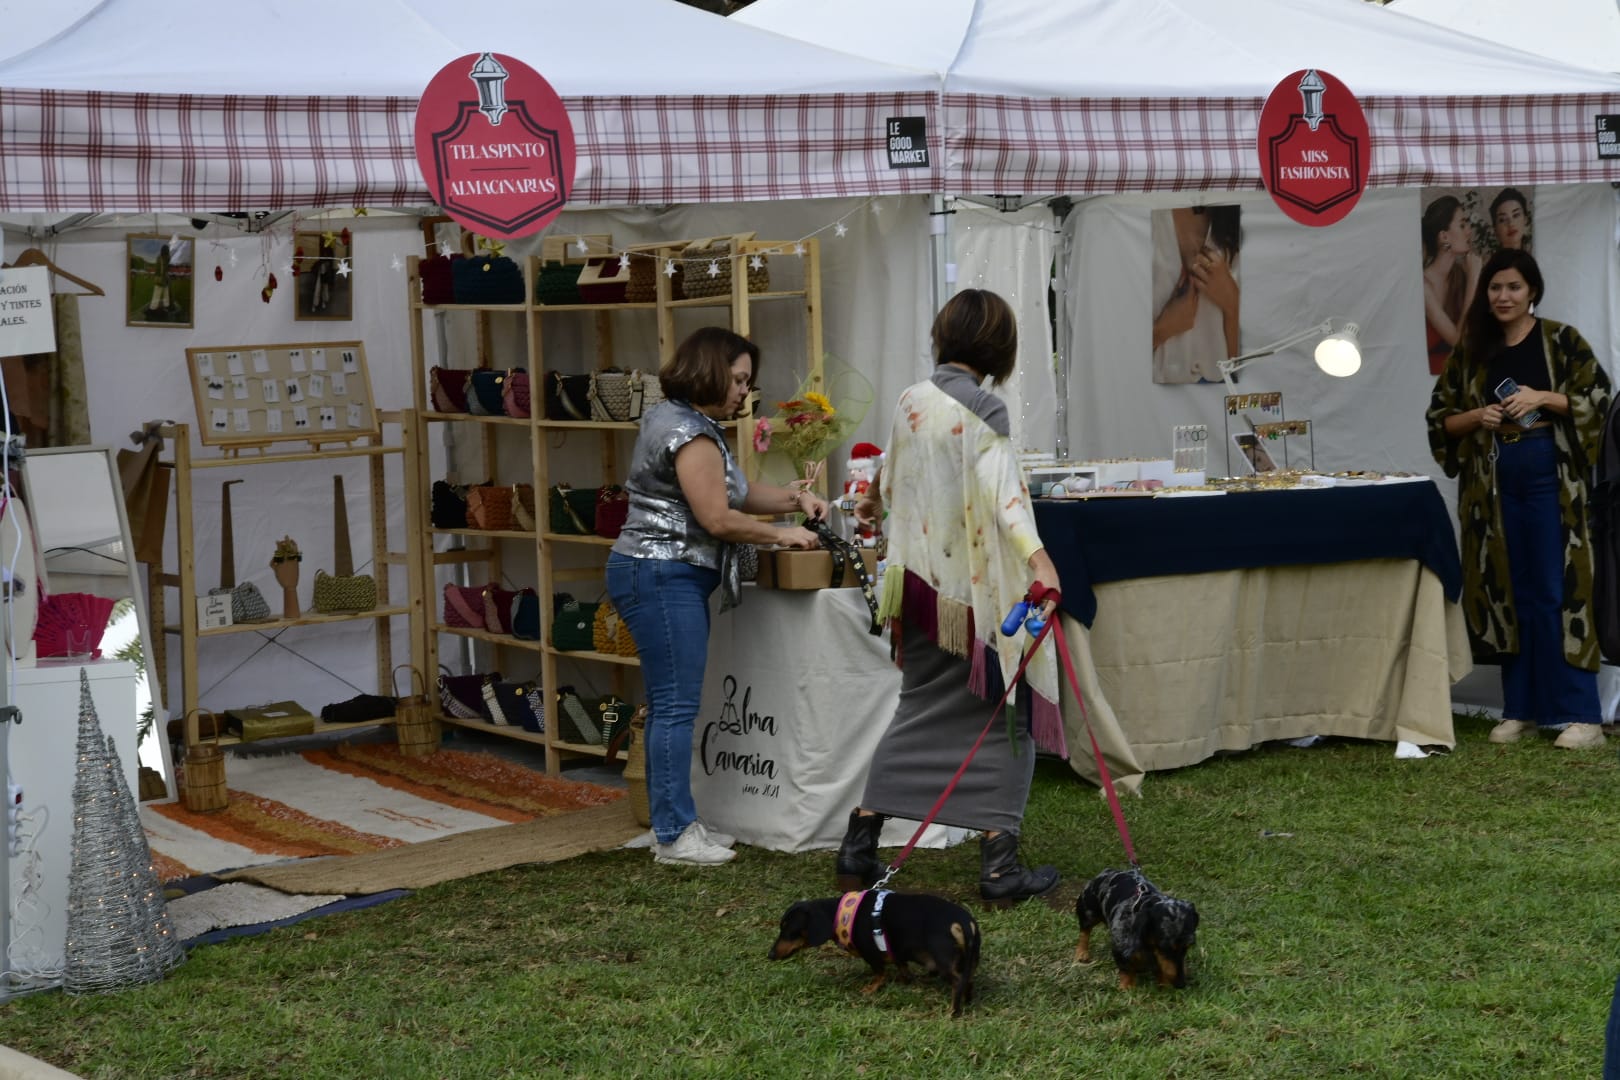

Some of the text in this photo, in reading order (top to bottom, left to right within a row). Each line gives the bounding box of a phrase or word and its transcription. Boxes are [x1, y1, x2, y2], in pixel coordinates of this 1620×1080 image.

[889, 121, 900, 136] LE
[1597, 118, 1607, 131] LE
[889, 136, 912, 150] GOOD
[449, 142, 545, 160] TELASPINTO
[891, 149, 926, 164] MARKET
[1301, 149, 1328, 163] MISS
[1280, 166, 1350, 180] FASHIONISTA
[1, 299, 42, 311] Y TINTES
[719, 674, 779, 736] Alma
[701, 721, 779, 780] Canaria
